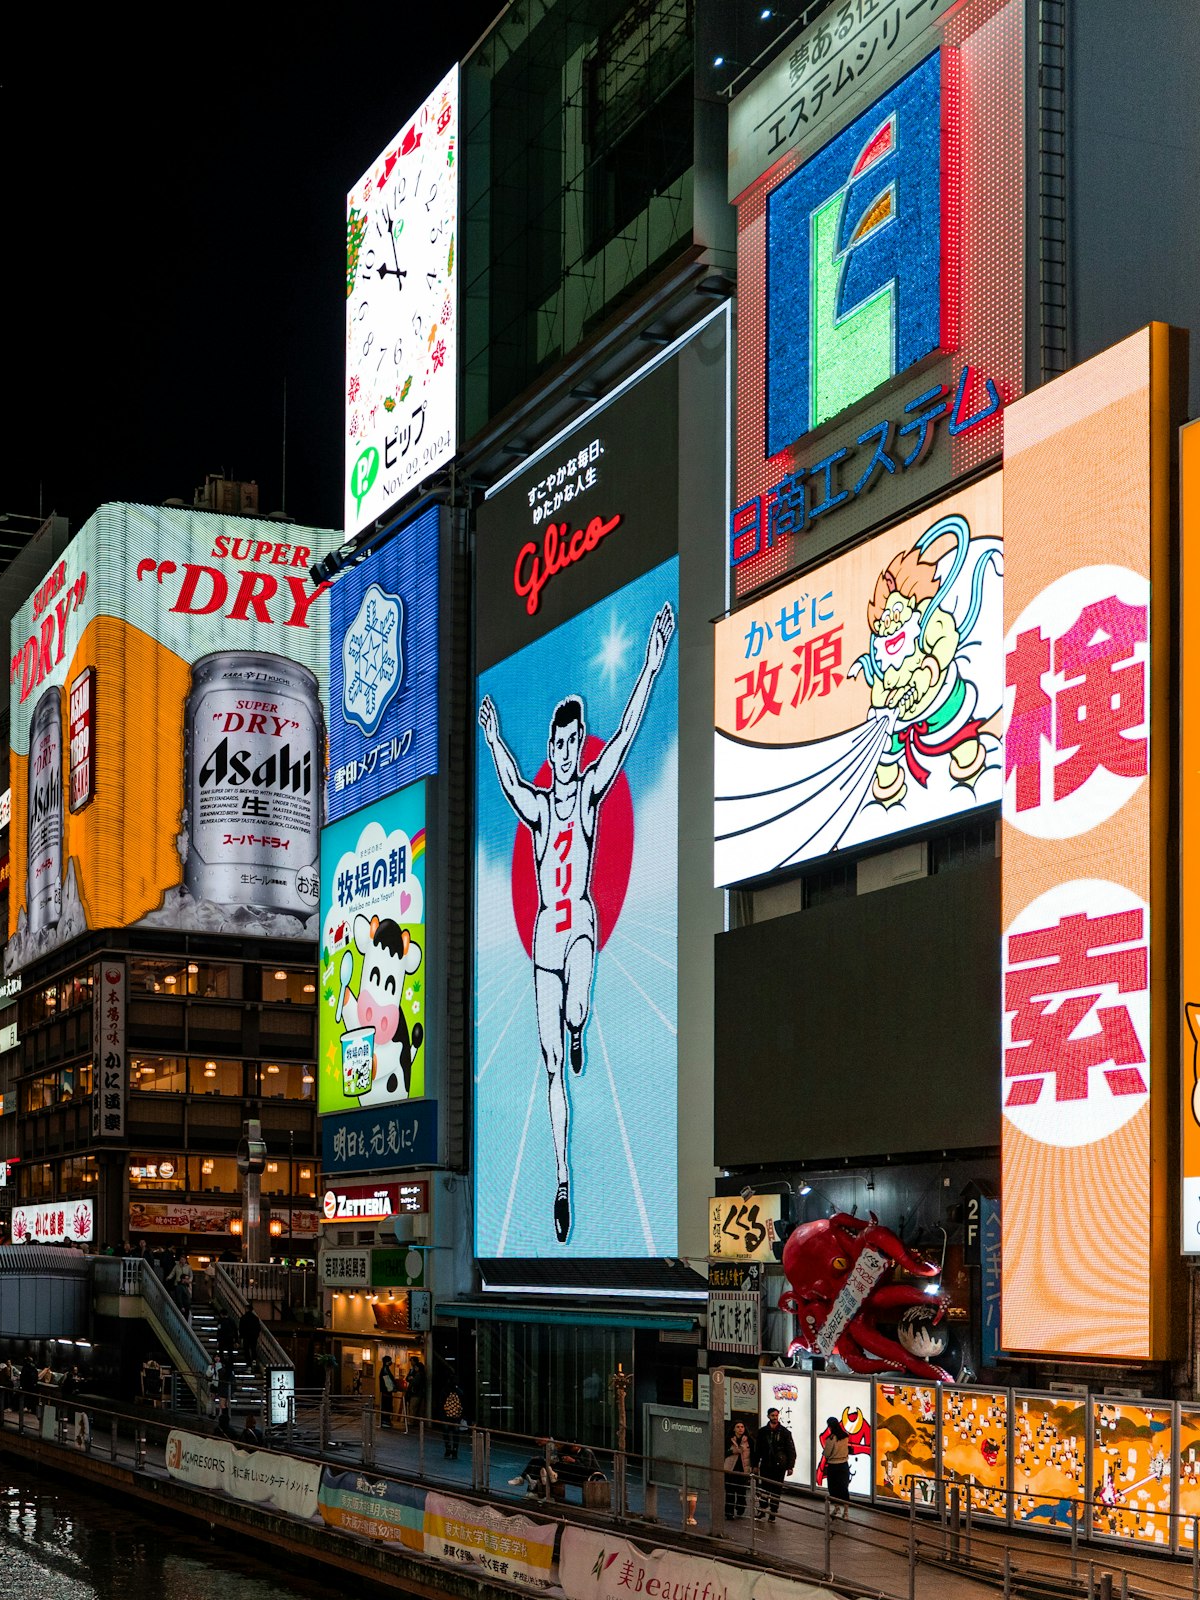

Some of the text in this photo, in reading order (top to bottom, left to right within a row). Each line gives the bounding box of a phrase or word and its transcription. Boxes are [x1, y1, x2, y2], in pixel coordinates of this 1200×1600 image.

[768, 0, 941, 155] エステムシリー
[384, 399, 428, 470] ピップ
[382, 476, 405, 501] Nov.
[422, 430, 452, 467] 2024
[528, 438, 605, 507] すこやかな毎日、
[730, 365, 1001, 567] 日商エステム
[532, 466, 598, 525] ゆたかな人生
[211, 534, 312, 568] SUPER
[513, 513, 622, 616] Glico
[32, 559, 67, 623] SUPER
[744, 590, 836, 660] かぜに
[70, 680, 90, 727] ASAHI
[243, 671, 268, 681] 辛口
[734, 622, 845, 732] 改源
[236, 699, 279, 714] SUPER
[70, 727, 90, 771] 1889
[198, 735, 311, 797] Asahi
[333, 728, 413, 793] 雪印メグミルク
[29, 764, 60, 830] Asahi
[70, 764, 89, 807] OSAKA
[241, 796, 271, 818] 生
[222, 834, 291, 850] スーパードライ
[1003, 594, 1152, 1110] 検索
[240, 873, 271, 887] 生ビール
[337, 844, 407, 908] 牧場の朝
[371, 896, 380, 907] Asa
[380, 890, 395, 906] Yogurt
[552, 821, 575, 934] グリコ
[105, 988, 121, 1046] 本場の味
[346, 1043, 370, 1061] 牧場の朝
[104, 1051, 122, 1132] かに道楽
[35, 1210, 65, 1237] かに道楽
[336, 1194, 393, 1217] ZETTERIA
[722, 1203, 766, 1253] くくる
[966, 1198, 979, 1247] 2F
[855, 1263, 875, 1285] 2025
[671, 1423, 703, 1434] information
